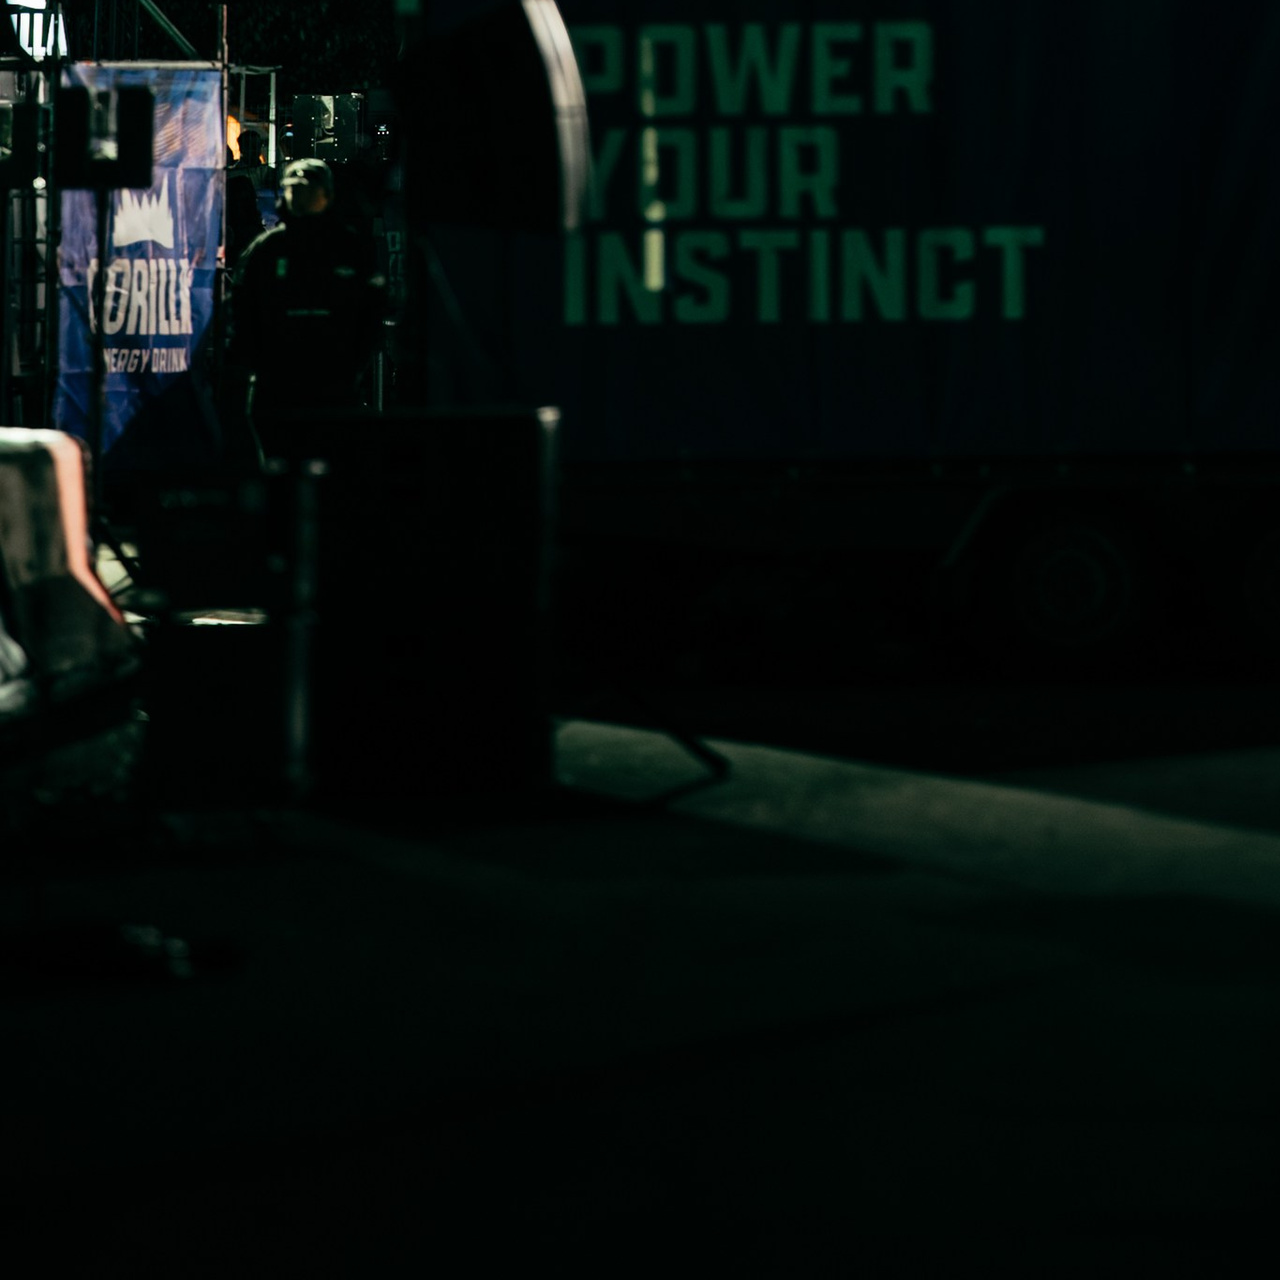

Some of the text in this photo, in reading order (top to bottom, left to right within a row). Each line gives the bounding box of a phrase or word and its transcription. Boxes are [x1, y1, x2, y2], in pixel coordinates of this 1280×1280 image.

[573, 20, 936, 117] POWER
[562, 226, 1046, 327] INSTINCT
[103, 347, 188, 373] NERGY DRINK
